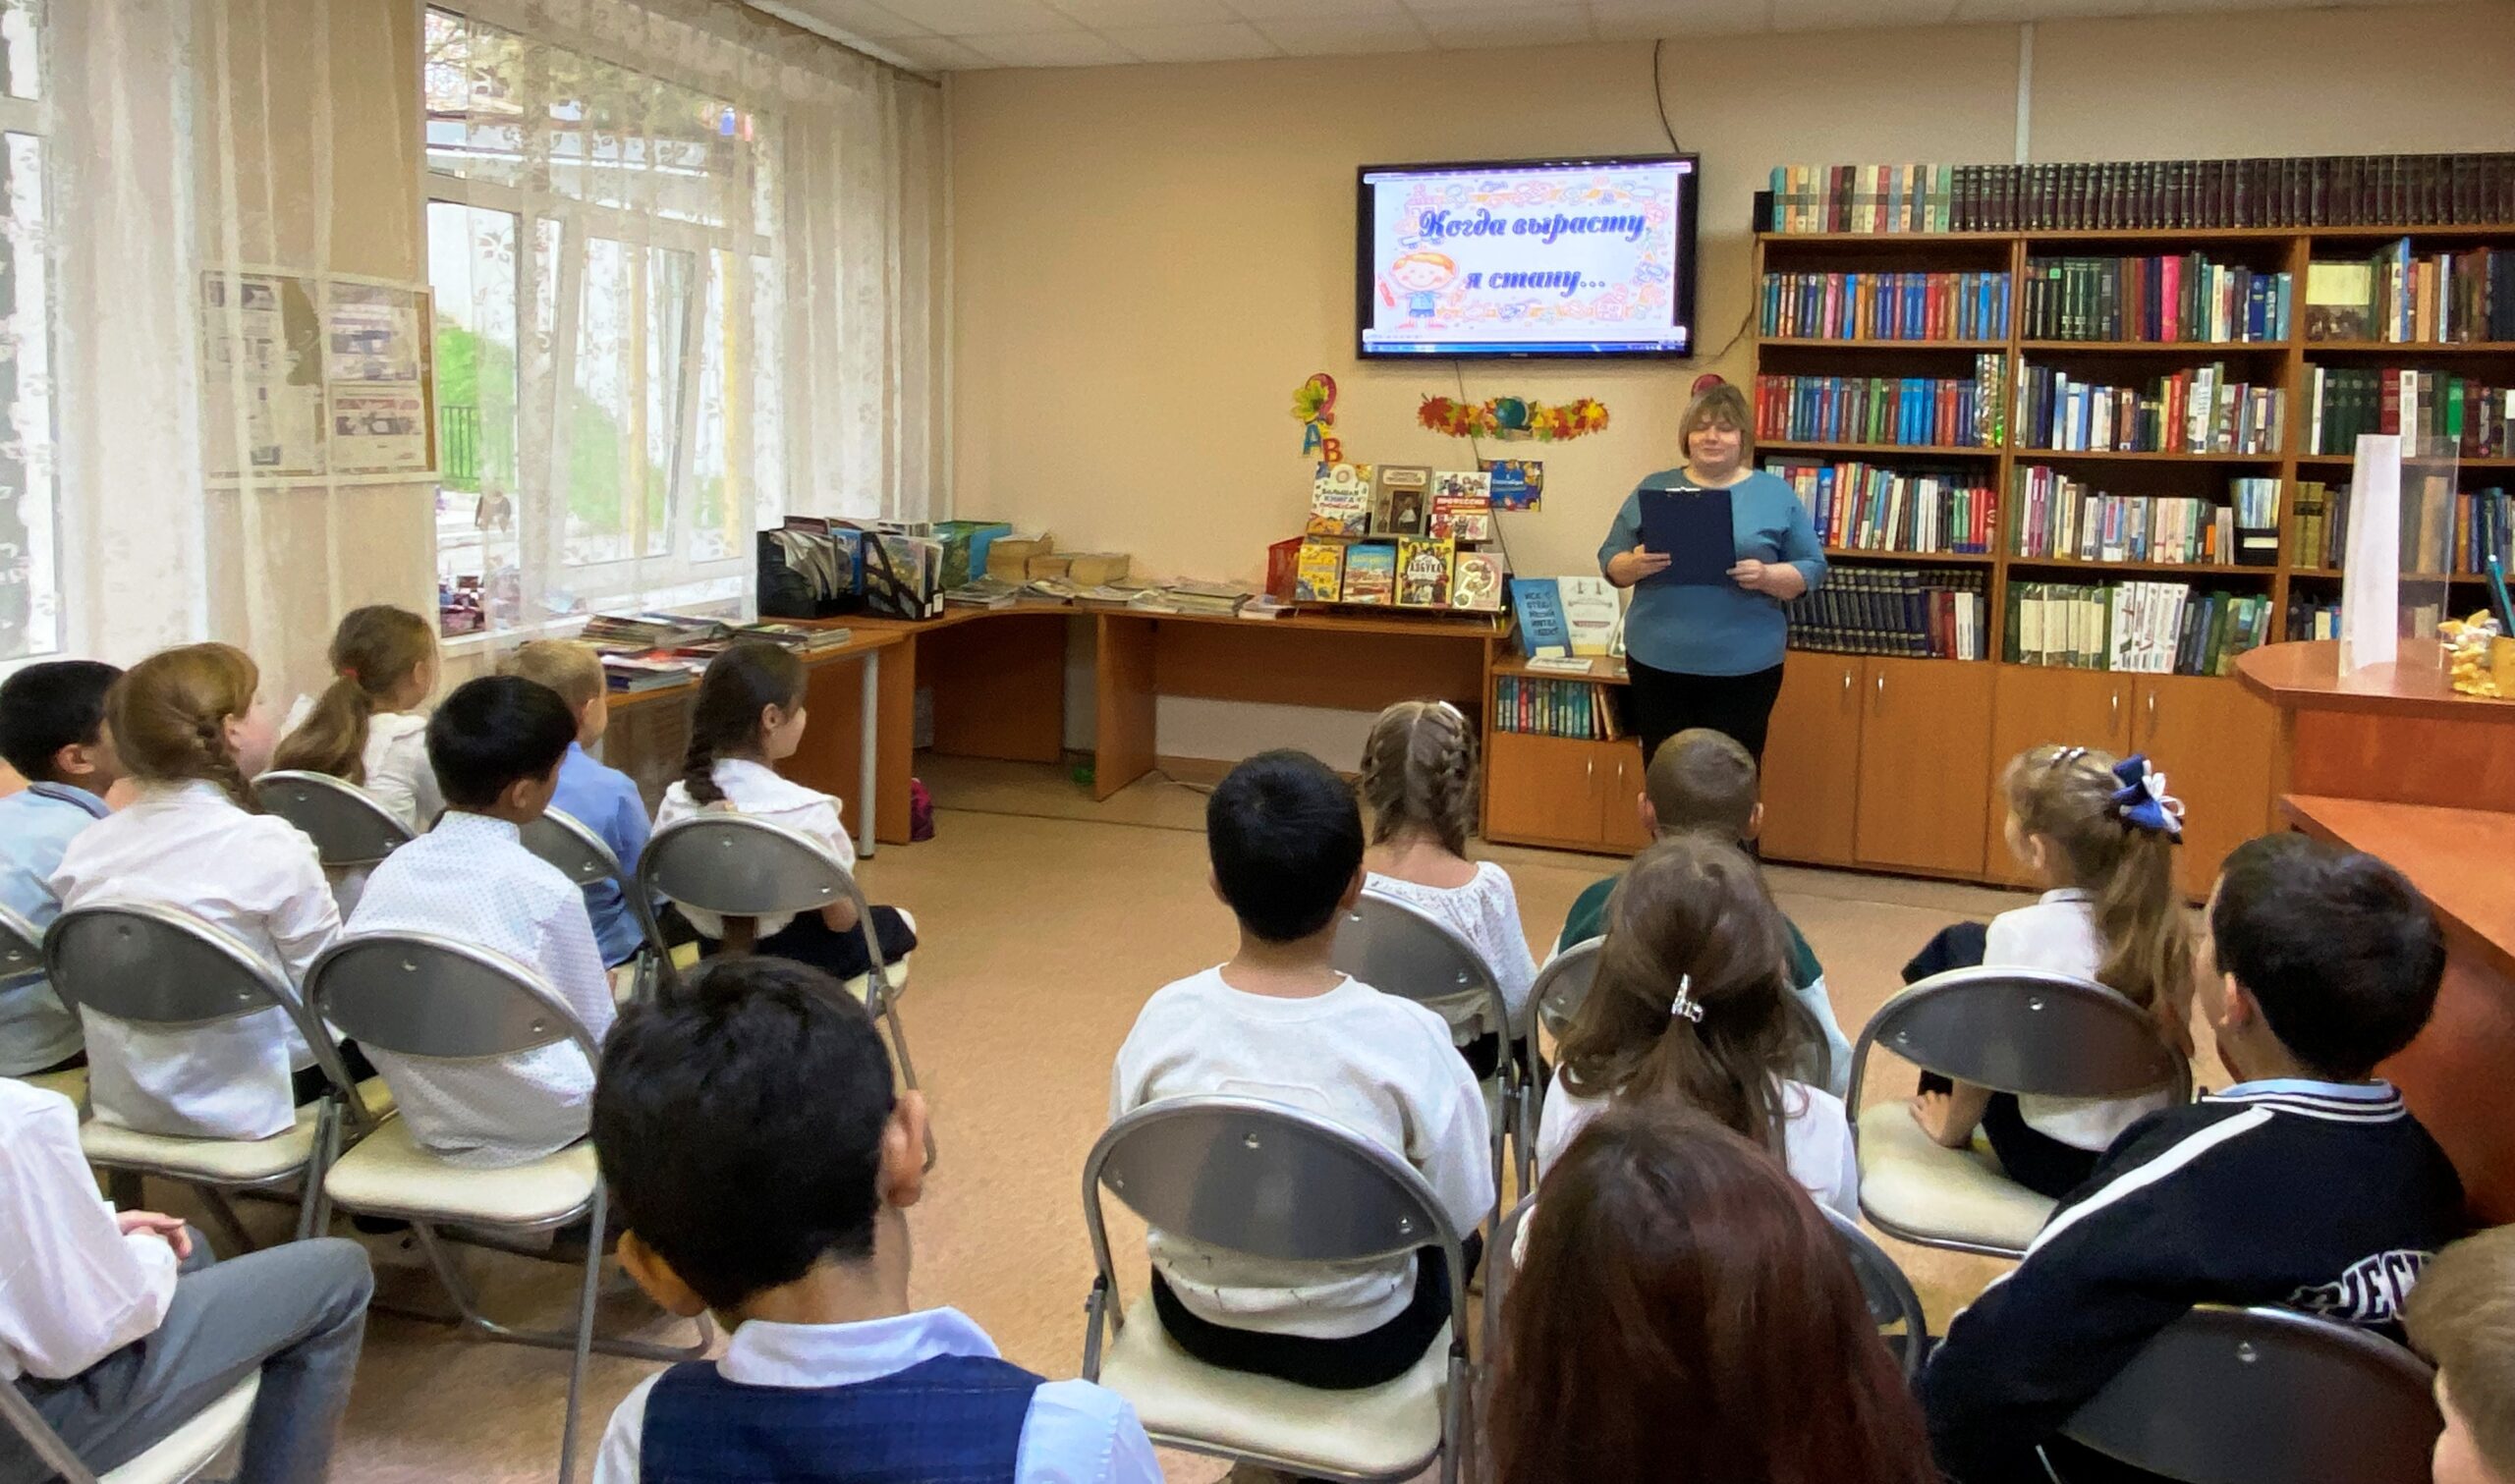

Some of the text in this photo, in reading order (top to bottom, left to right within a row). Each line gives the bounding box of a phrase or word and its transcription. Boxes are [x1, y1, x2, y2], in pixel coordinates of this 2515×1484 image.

[1419, 208, 1505, 238] Когда
[1465, 269, 1605, 298] я стану...
